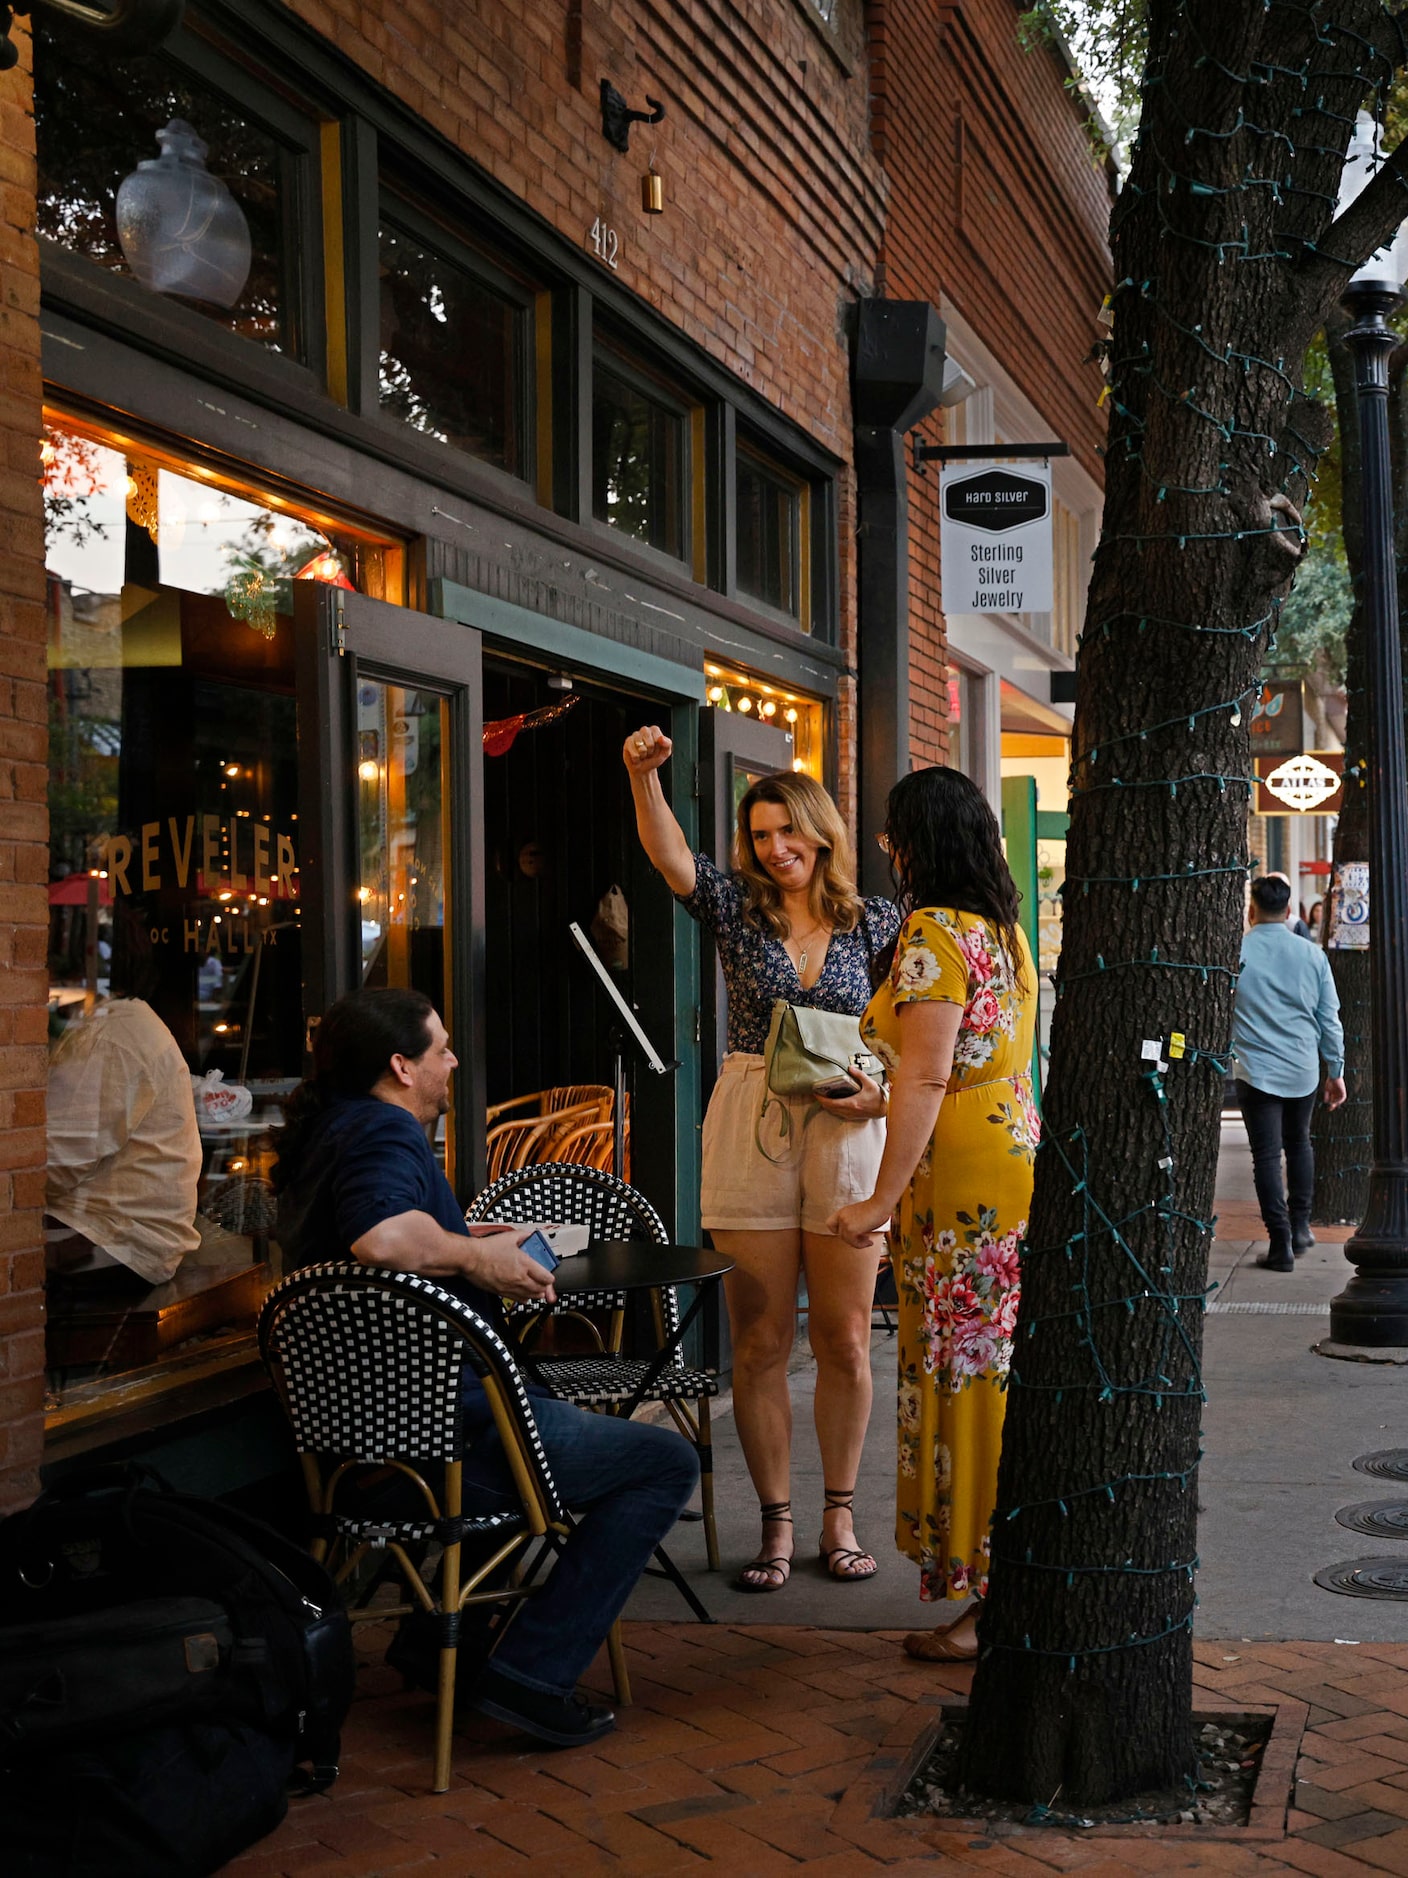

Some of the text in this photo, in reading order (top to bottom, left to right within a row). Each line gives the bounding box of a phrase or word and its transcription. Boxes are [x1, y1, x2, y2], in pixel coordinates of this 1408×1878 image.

[591, 216, 618, 270] 412
[971, 543, 1023, 562] Sterling
[978, 567, 1016, 585] Silver
[972, 589, 1023, 609] Jewelry
[1281, 777, 1326, 788] ATLAS
[150, 918, 278, 954] OC HALL TX
